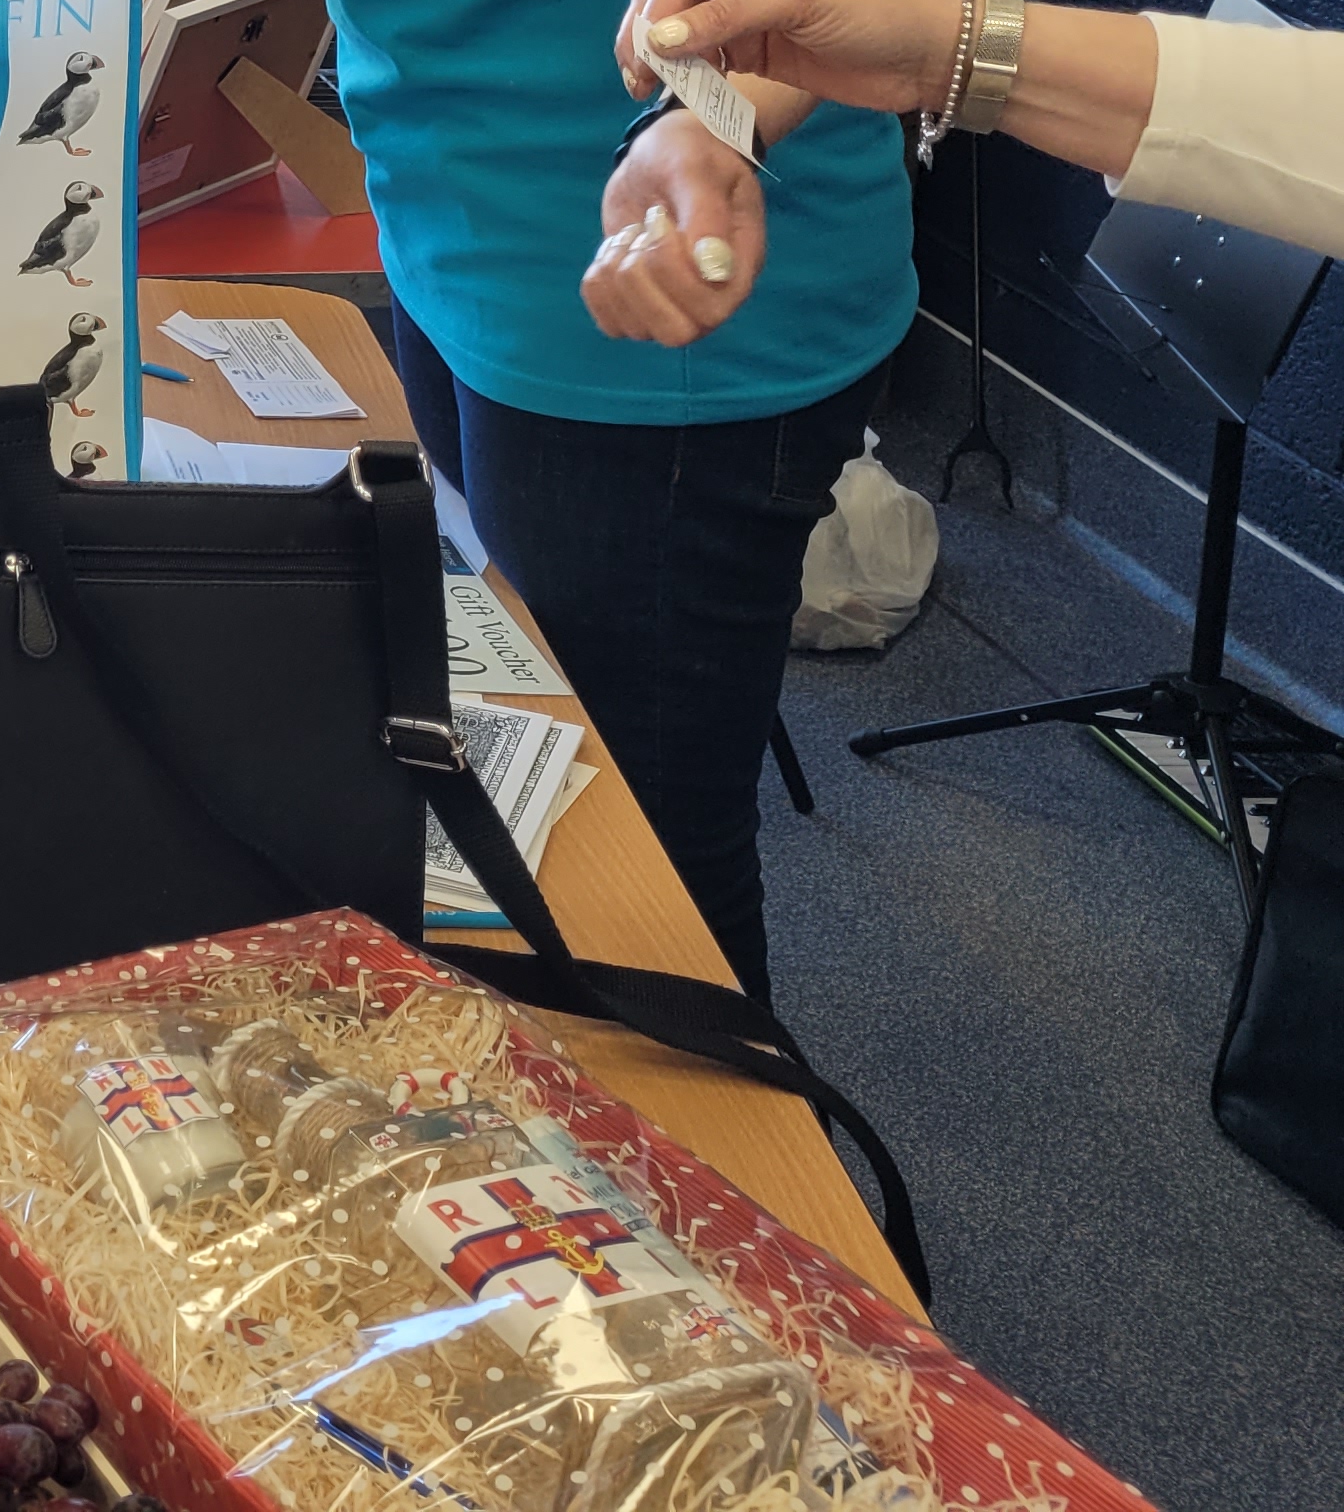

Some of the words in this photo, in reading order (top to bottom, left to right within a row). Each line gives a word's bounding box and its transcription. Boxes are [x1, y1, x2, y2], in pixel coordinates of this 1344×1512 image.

[450, 585, 495, 617] Gift
[476, 620, 541, 685] Voucher
[427, 1199, 483, 1233] R
[505, 1277, 560, 1310] L
